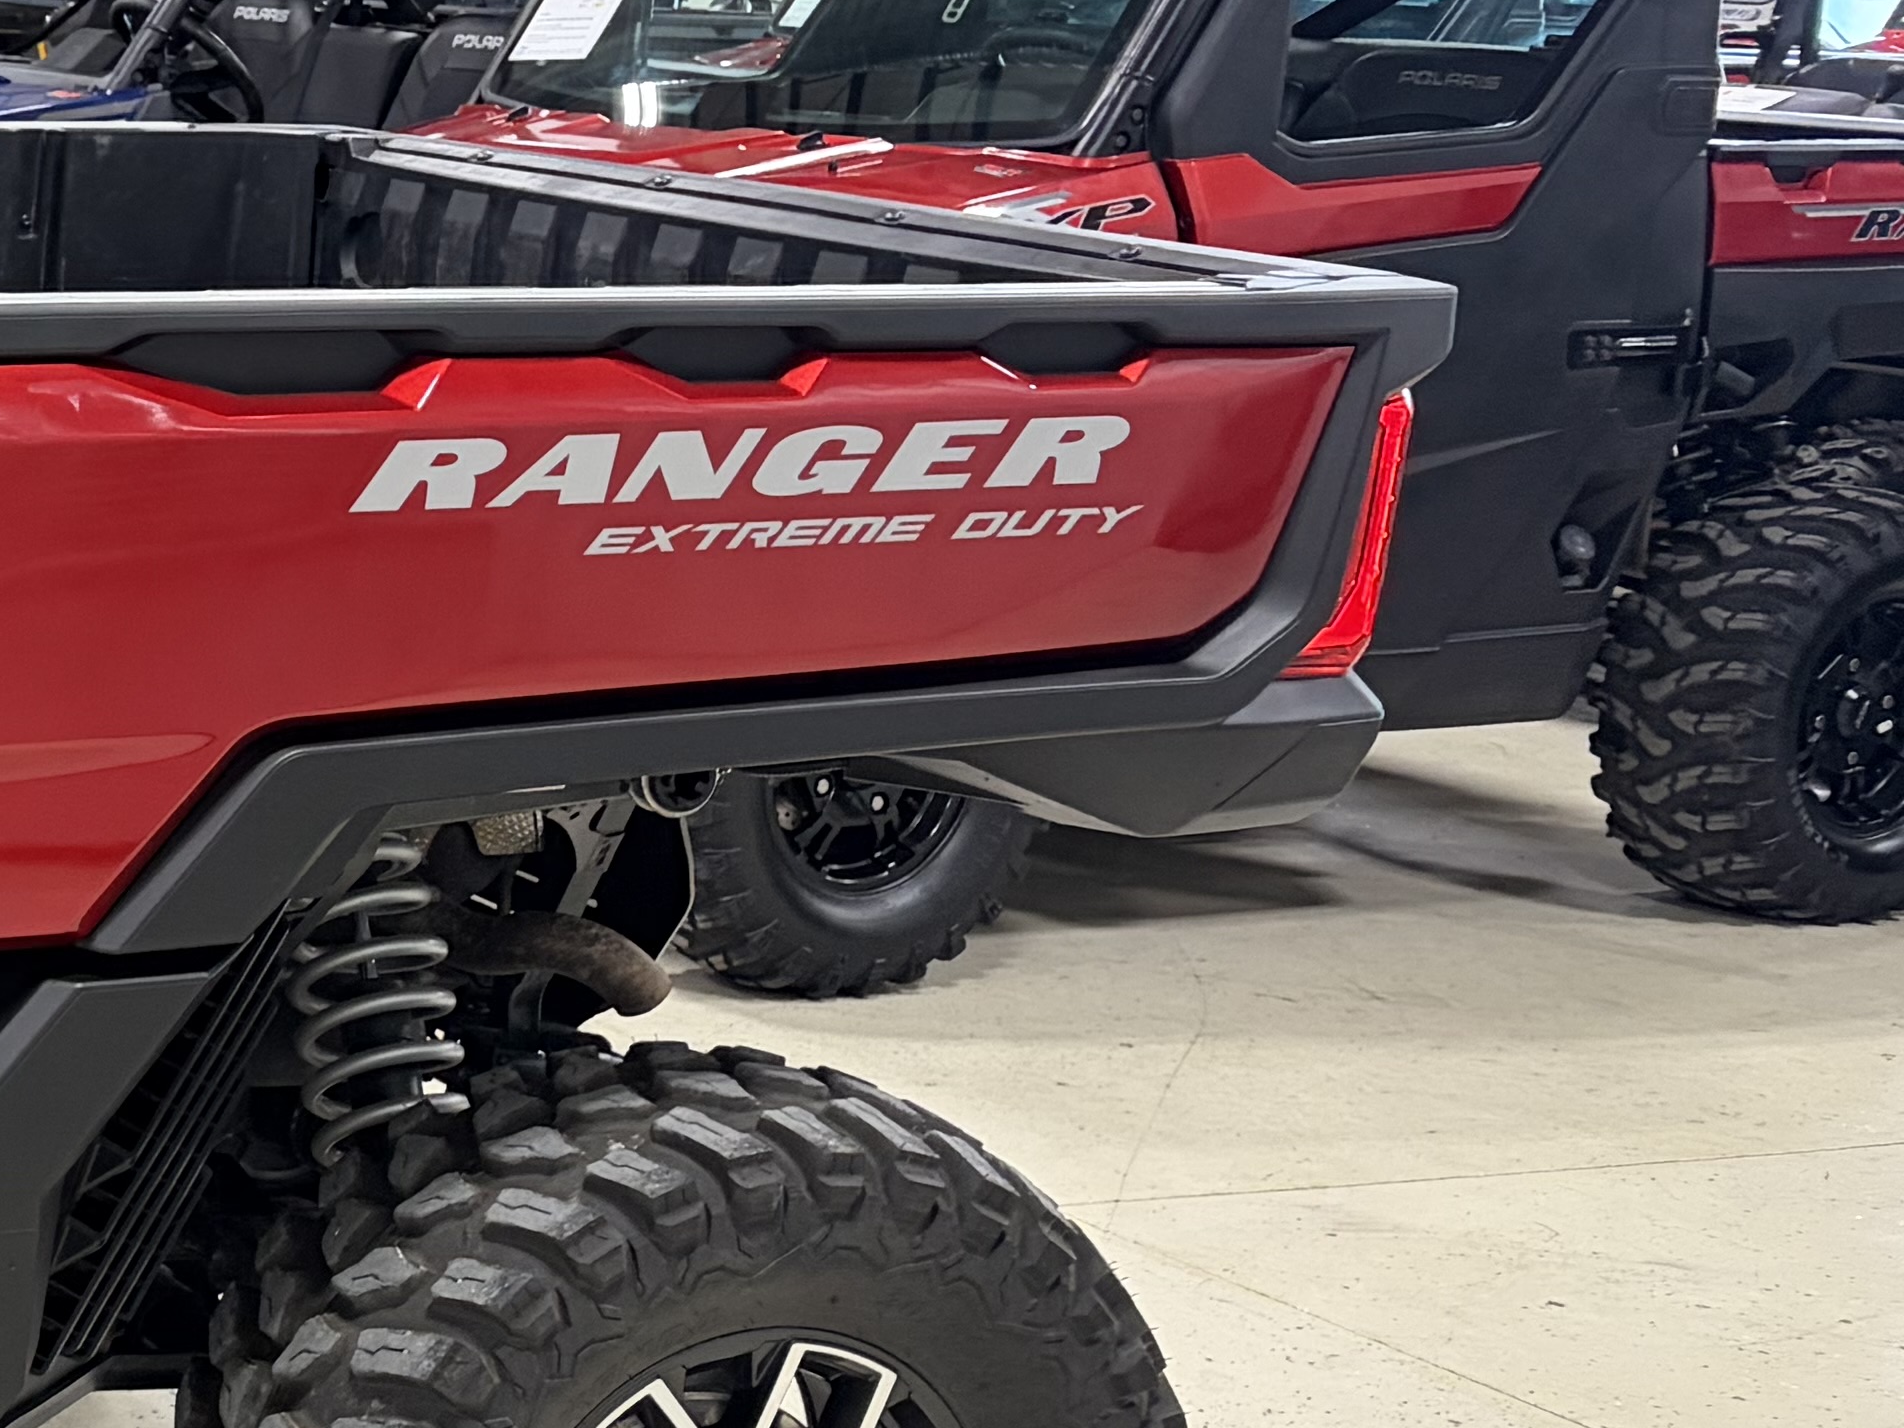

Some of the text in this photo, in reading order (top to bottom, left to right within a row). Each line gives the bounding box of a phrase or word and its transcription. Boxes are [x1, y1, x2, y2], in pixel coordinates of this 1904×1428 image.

[233, 5, 291, 23] POLARIS
[451, 33, 506, 50] POLAR
[1397, 70, 1504, 90] POLARIS
[348, 414, 1131, 513] RANGER
[583, 505, 1144, 556] EXTREME DUTY
